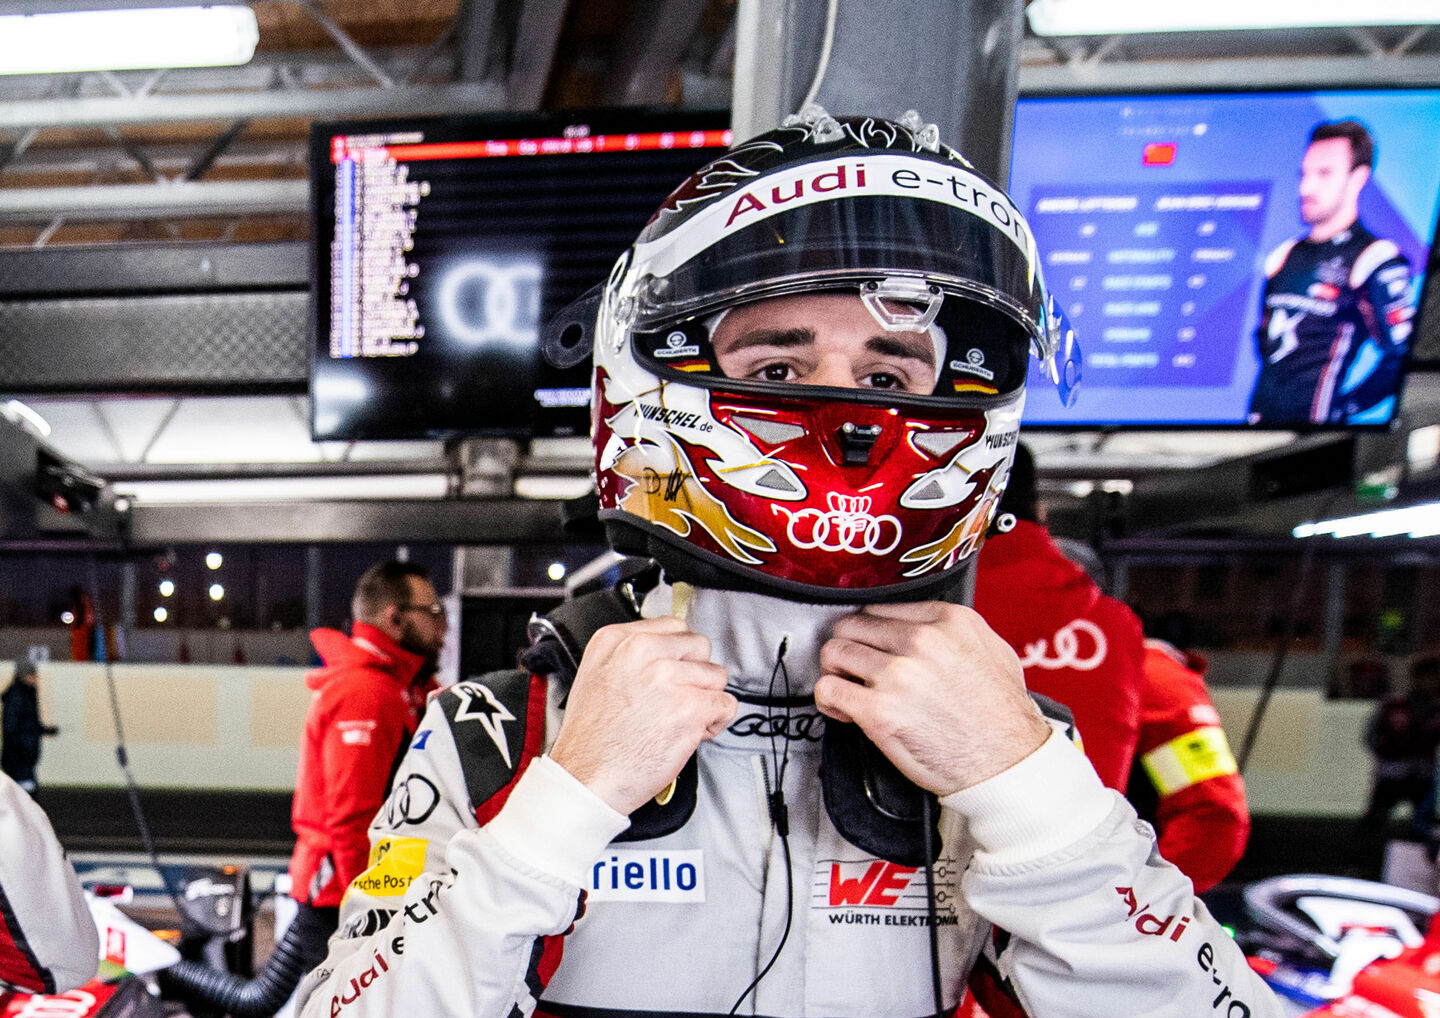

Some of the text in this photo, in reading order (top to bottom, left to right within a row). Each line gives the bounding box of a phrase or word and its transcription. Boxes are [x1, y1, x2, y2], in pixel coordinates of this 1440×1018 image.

[723, 162, 1030, 249] Audi e-tron
[592, 856, 698, 891] riello
[828, 860, 919, 907] WE
[828, 910, 881, 925] WÜRTH
